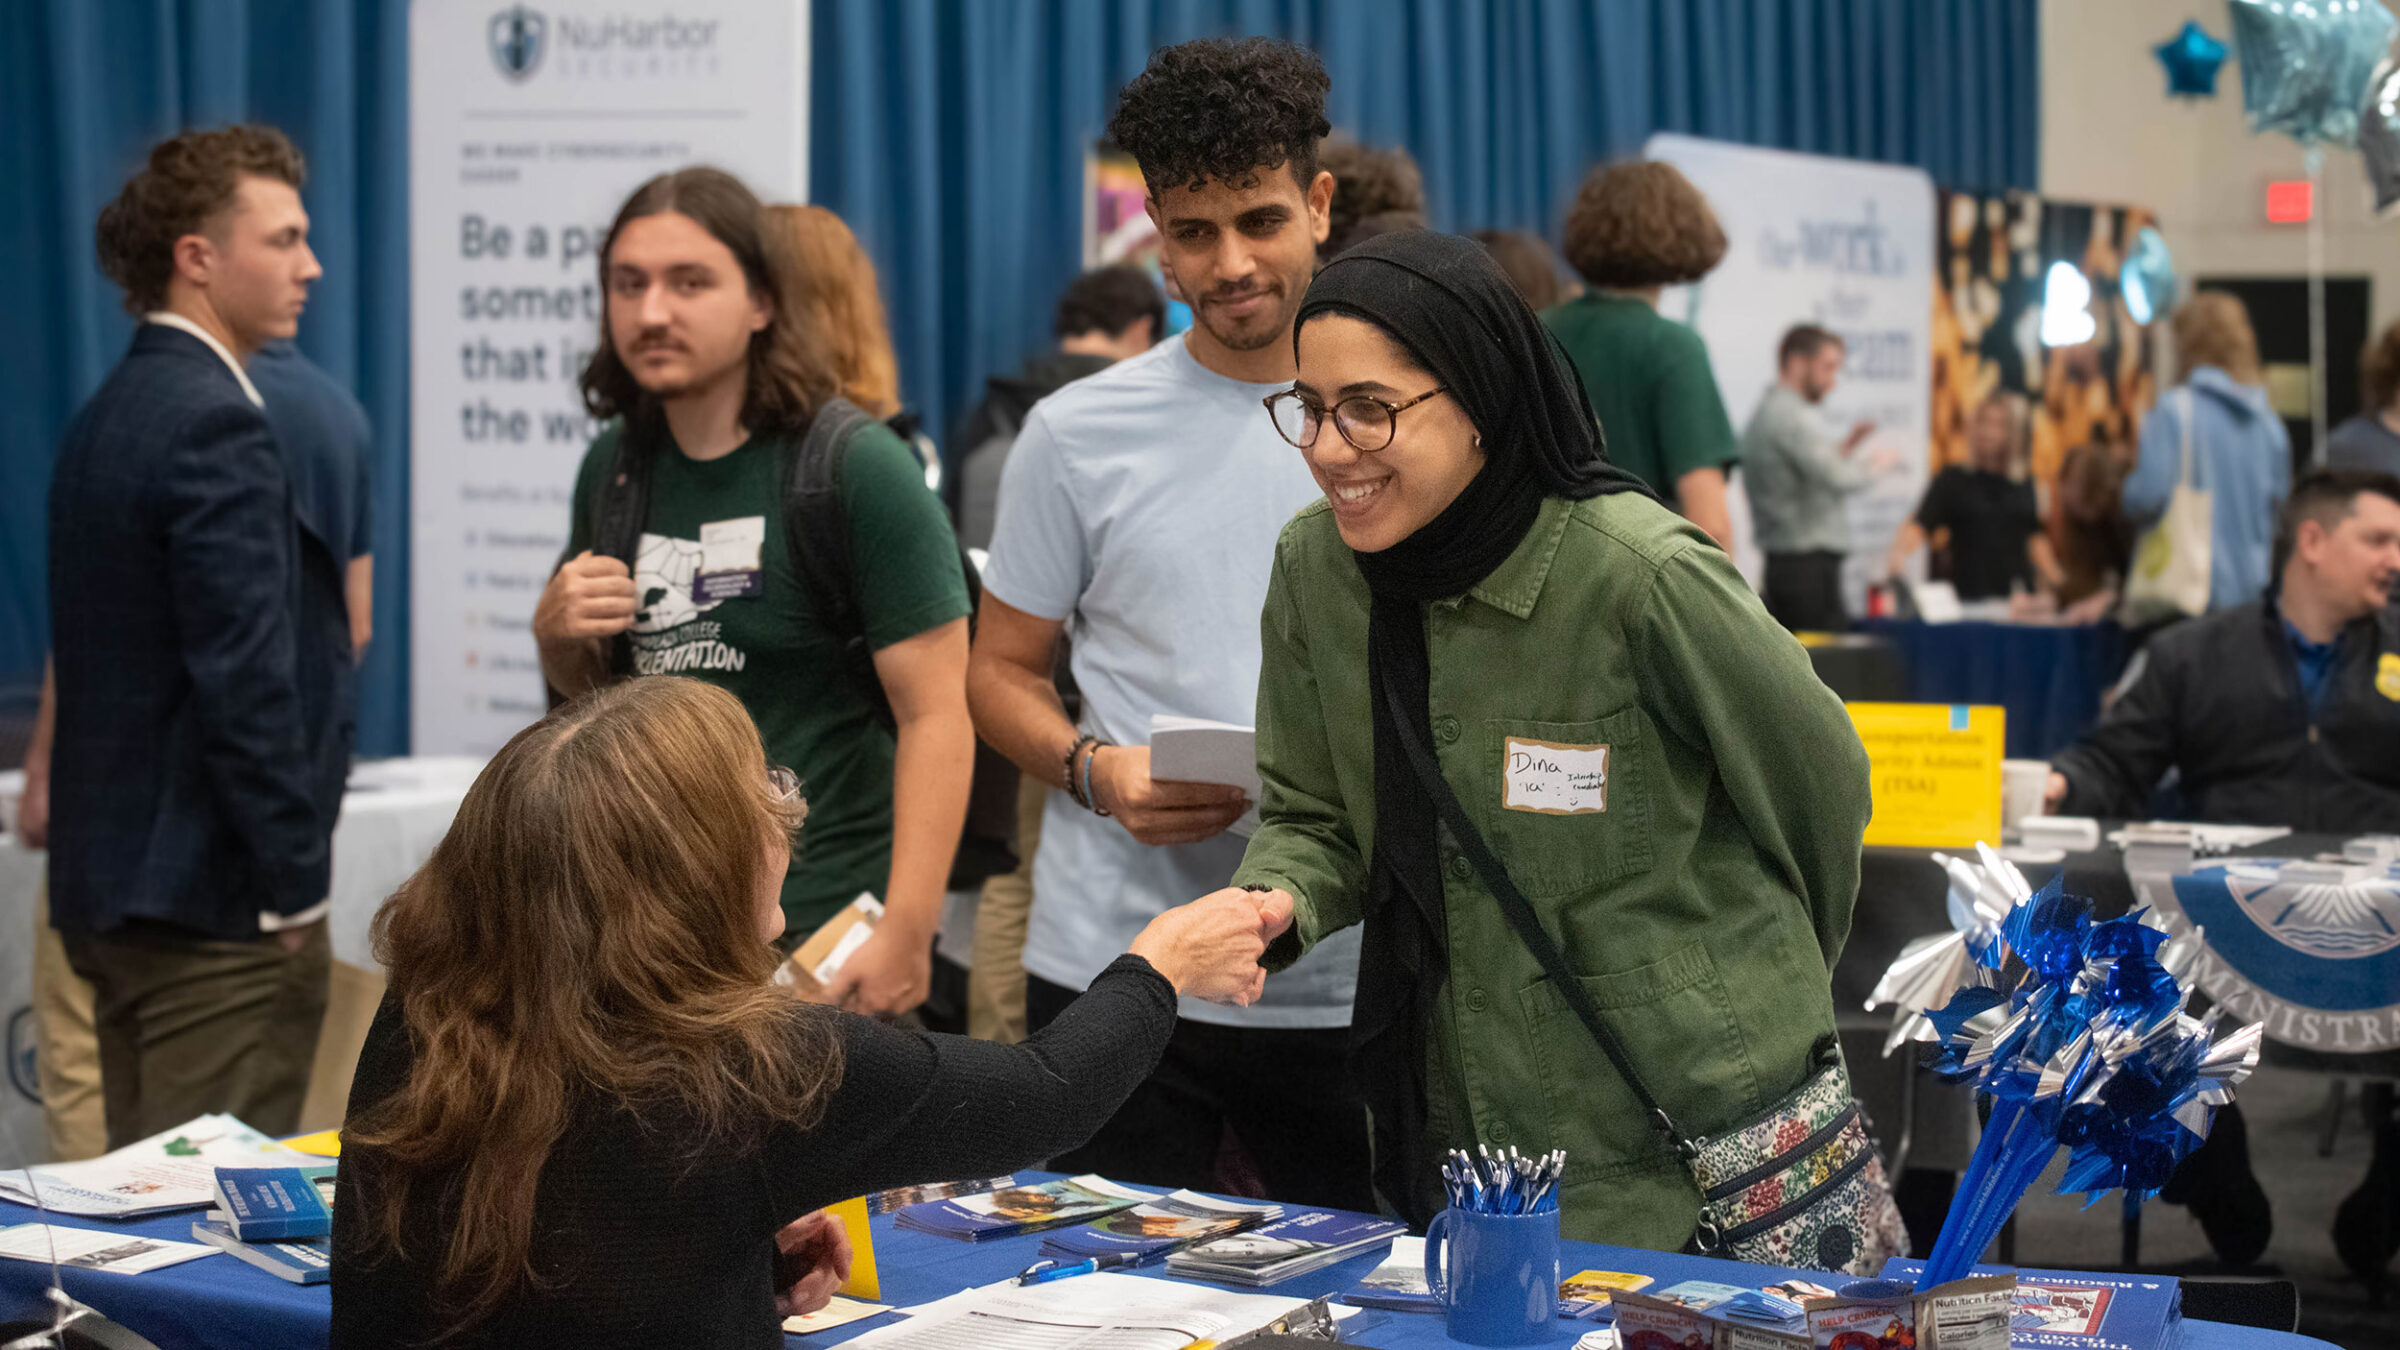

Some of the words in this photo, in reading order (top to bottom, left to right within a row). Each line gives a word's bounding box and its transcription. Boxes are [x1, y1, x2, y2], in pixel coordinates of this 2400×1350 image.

[557, 14, 719, 50] NuHarbor
[460, 216, 512, 259] Be
[525, 225, 549, 259] a
[562, 225, 604, 274] pa
[460, 284, 601, 321] somet
[460, 338, 548, 381] that
[460, 400, 529, 443] the
[542, 411, 604, 443] wo
[1511, 751, 1562, 775] Dina
[2025, 1276, 2133, 1289] RESOURCE
[1936, 1296, 1982, 1309] Nutrition
[1621, 1310, 1646, 1324] HELP
[1818, 1315, 1845, 1328] HELP
[1734, 1327, 1779, 1347] Nutrition
[1938, 1327, 1978, 1341] Calories
[2039, 1333, 2106, 1344] HOME
